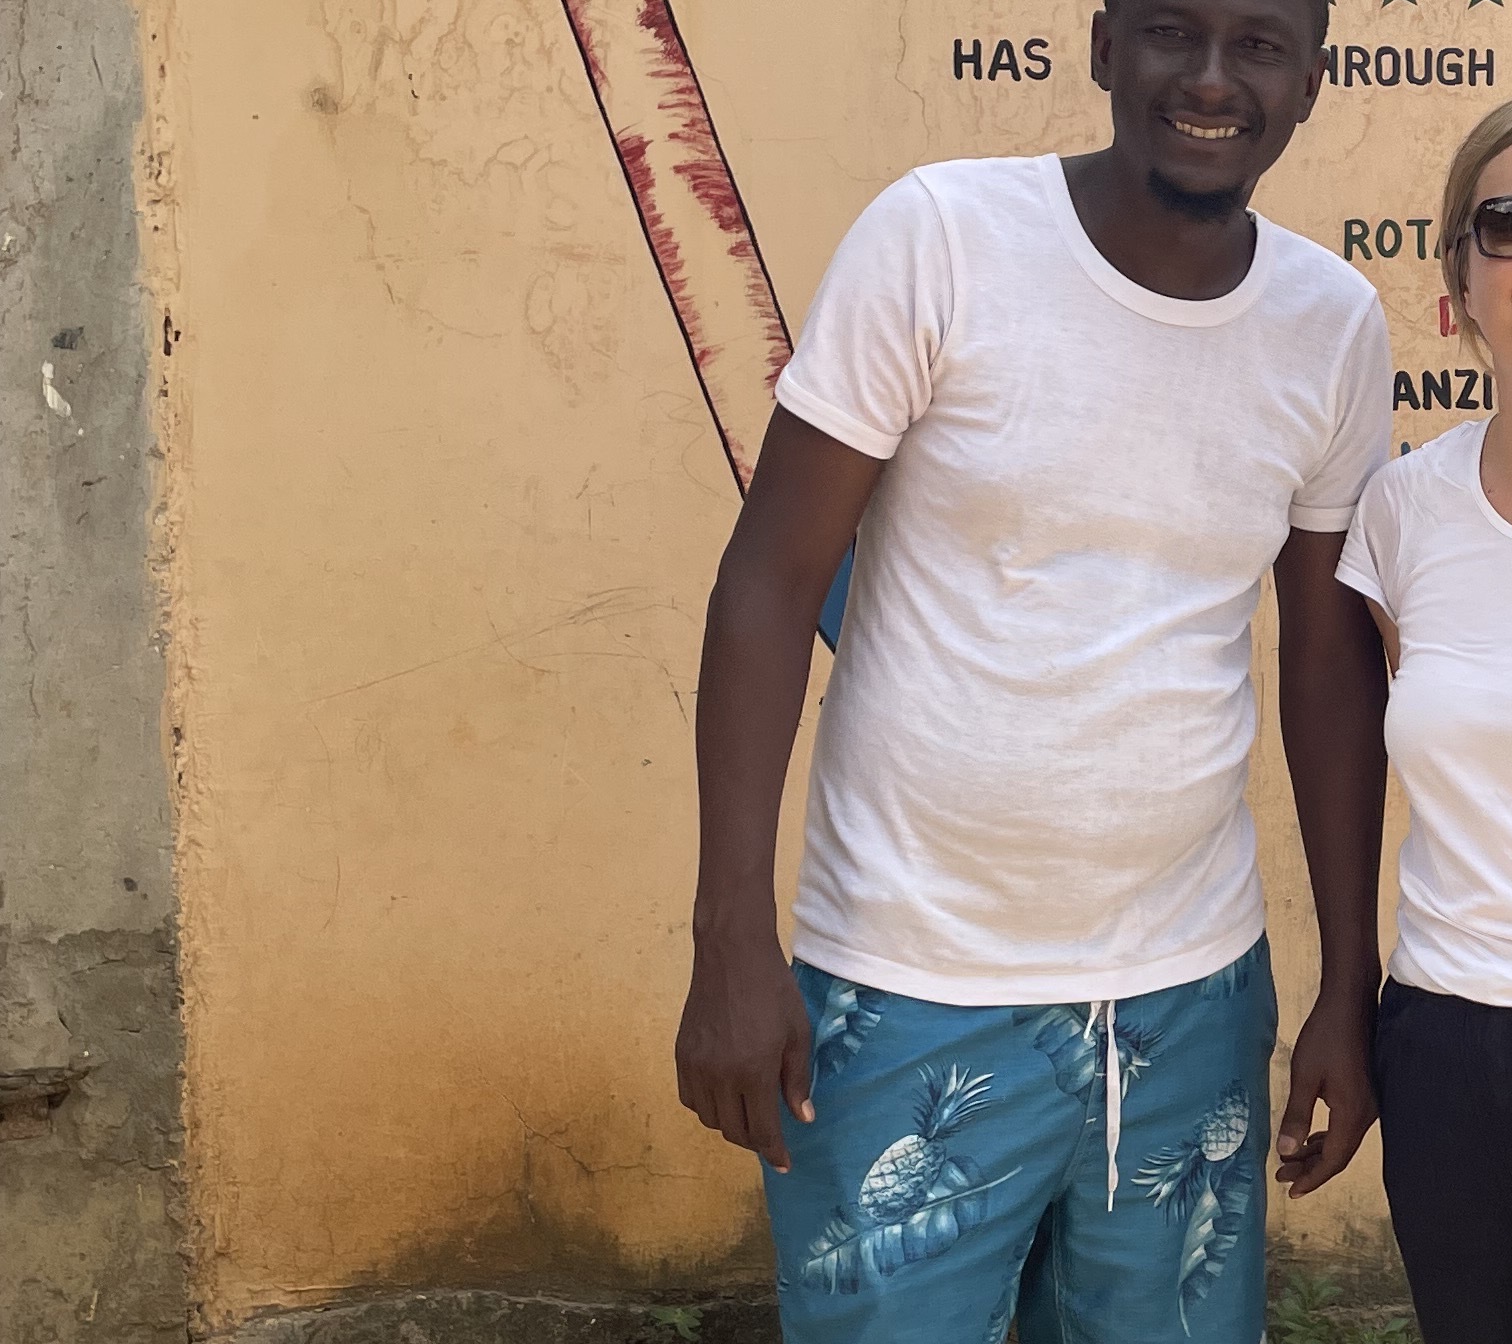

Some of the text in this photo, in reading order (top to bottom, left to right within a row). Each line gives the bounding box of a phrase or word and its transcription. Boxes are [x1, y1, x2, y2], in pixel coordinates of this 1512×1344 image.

[953, 38, 1051, 81] HAS
[1325, 45, 1493, 87] HROUGH
[1344, 219, 1441, 260] ROT
[1393, 369, 1494, 410] ANZI
